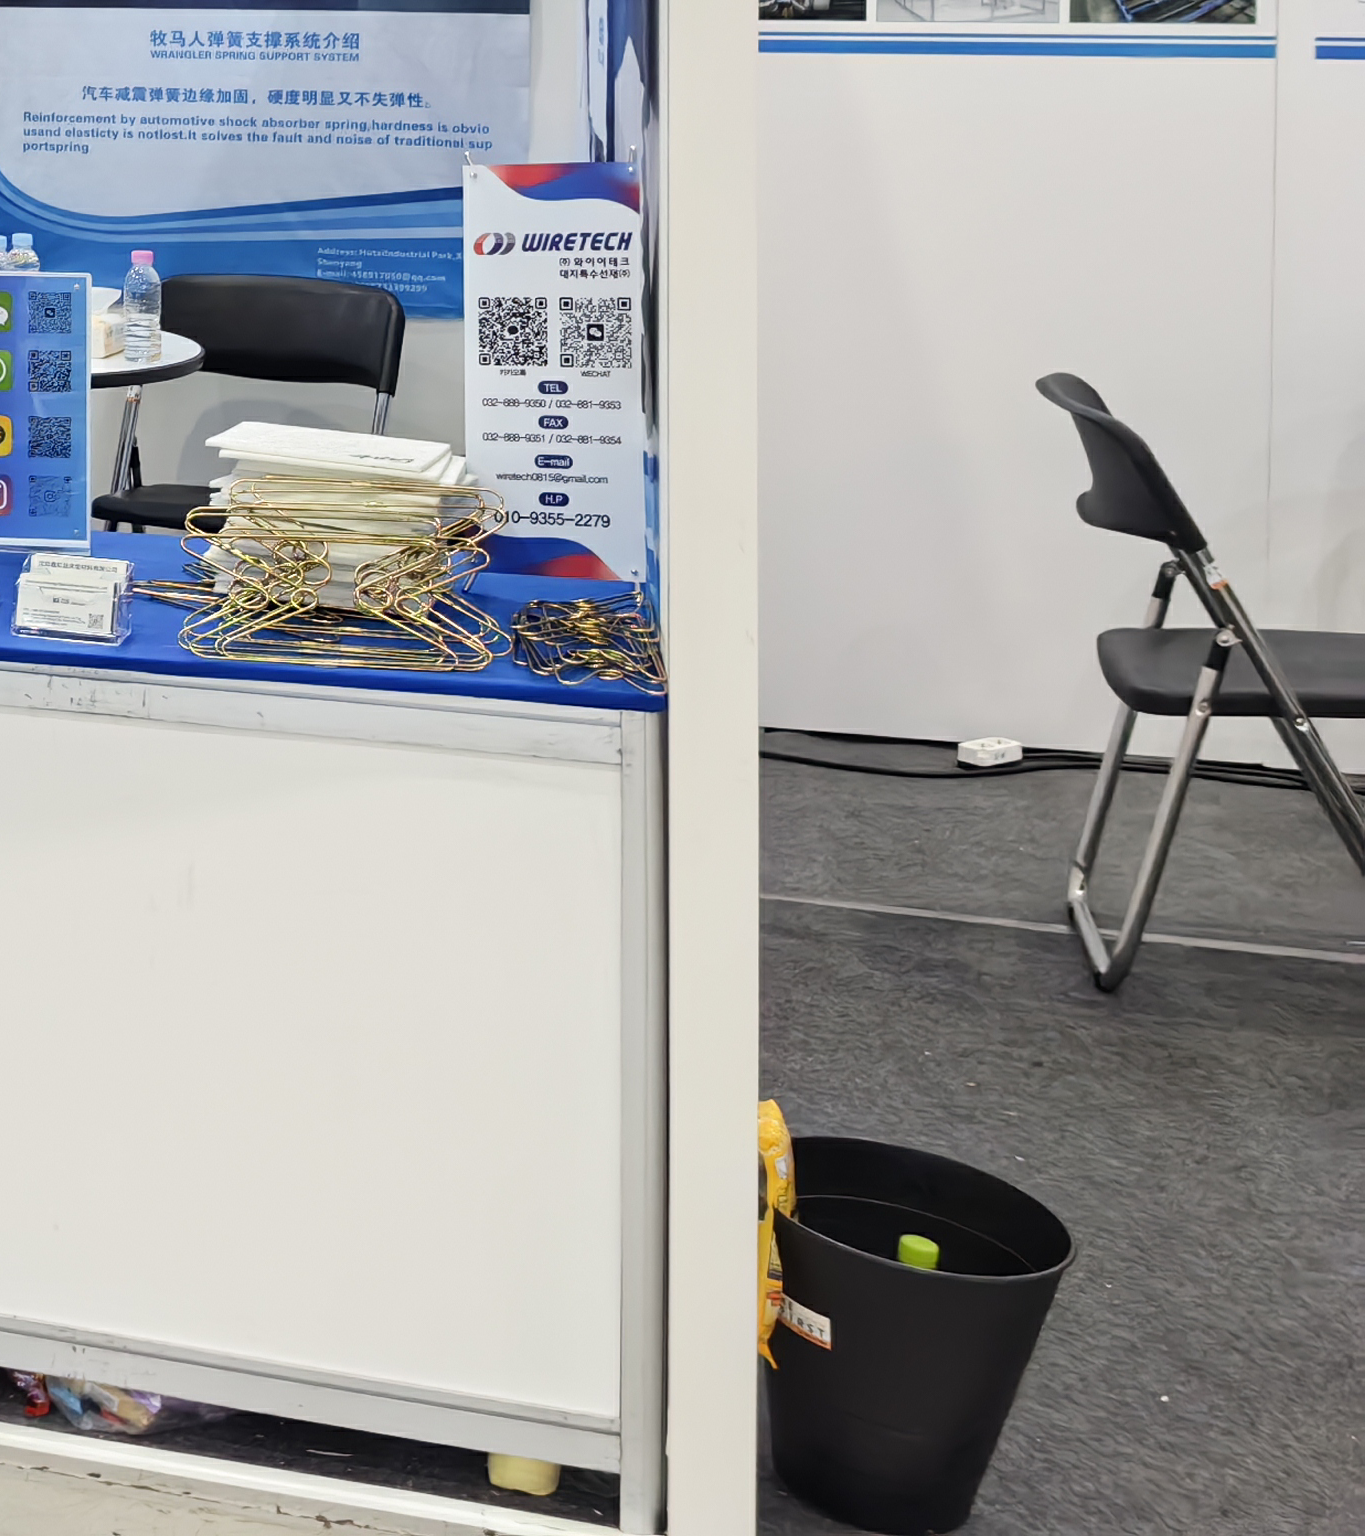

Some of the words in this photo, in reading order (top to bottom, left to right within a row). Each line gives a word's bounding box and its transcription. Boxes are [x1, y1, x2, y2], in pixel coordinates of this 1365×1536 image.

[150, 29, 360, 50] 牧马人弹簧支撑系统介绍
[150, 50, 211, 59] WRANGLER
[215, 51, 256, 60] SPRING
[259, 51, 310, 61] SUPPORT
[313, 52, 359, 62] SYSTEM
[23, 112, 116, 124] Reinforcement
[120, 114, 136, 126] by
[219, 116, 257, 127] shock
[22, 141, 89, 154] portspring
[272, 132, 302, 143] fault
[307, 133, 332, 144] and
[336, 134, 372, 145] noise
[377, 134, 390, 145] of
[395, 135, 464, 148] traditional
[469, 138, 493, 151] sup
[521, 232, 633, 252] WIRETECH
[543, 384, 562, 392] TEL
[543, 418, 564, 427] FAX
[537, 457, 570, 467] E-mail
[494, 511, 611, 528] 010-9355-2279
